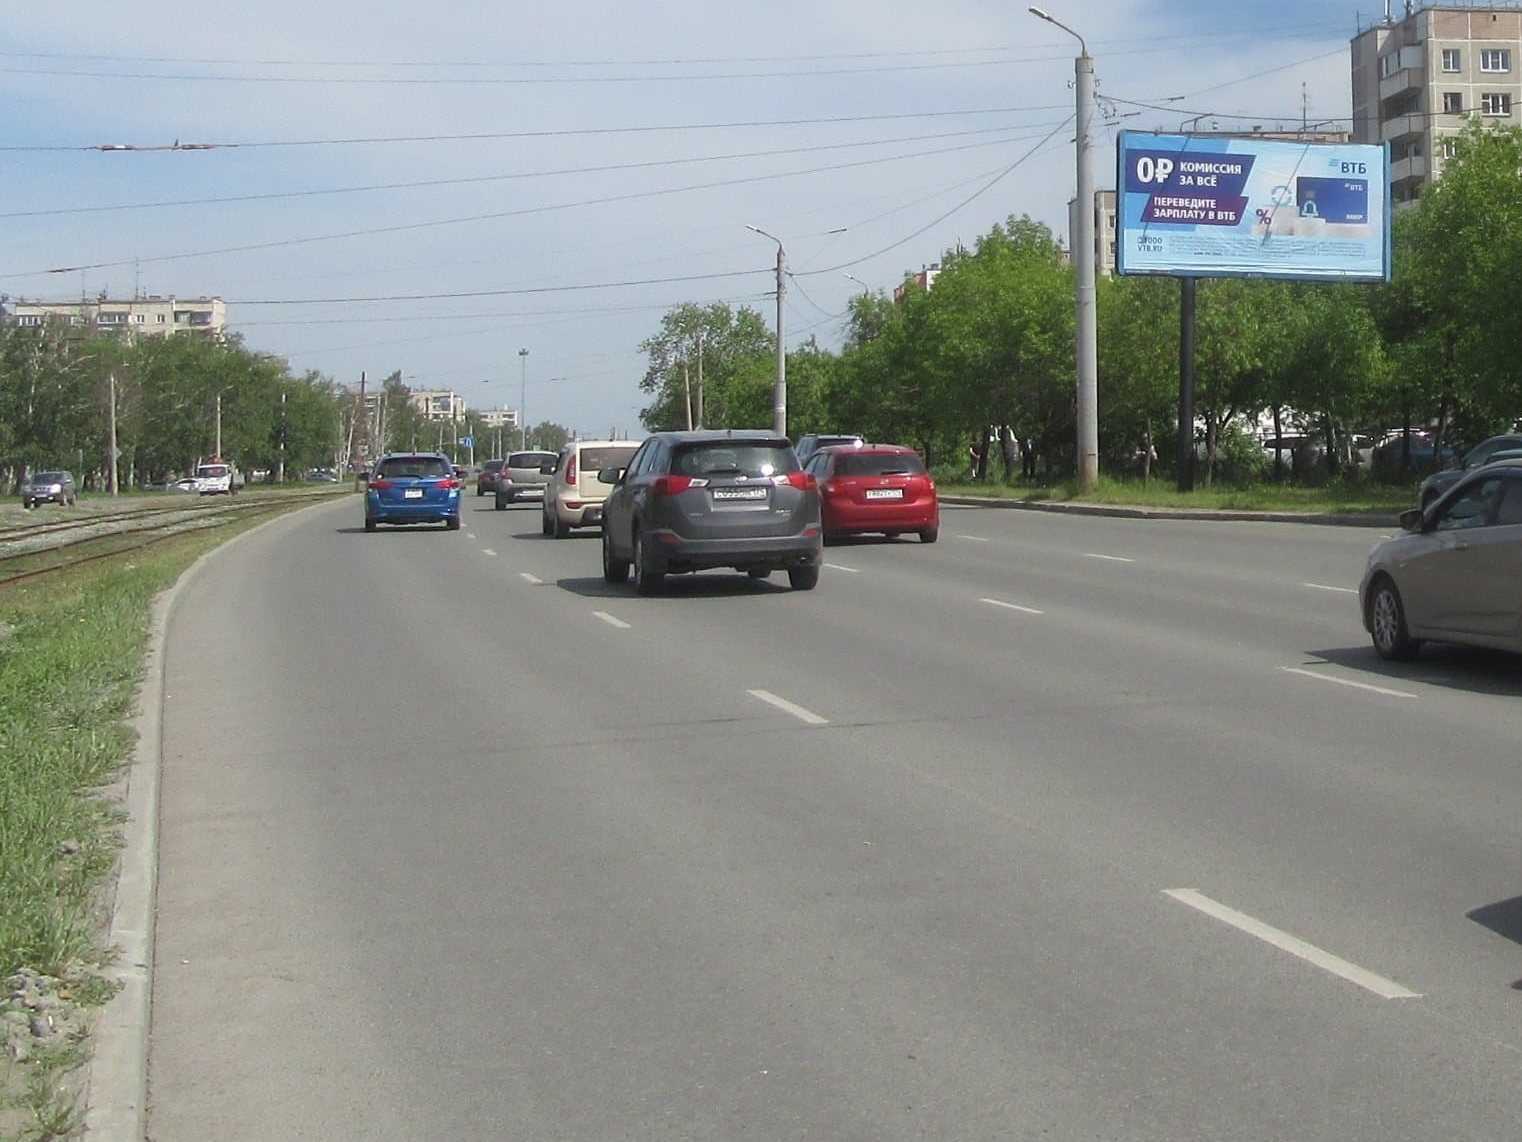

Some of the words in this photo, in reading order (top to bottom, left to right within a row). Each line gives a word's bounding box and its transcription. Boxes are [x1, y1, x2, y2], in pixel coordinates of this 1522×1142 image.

[1180, 161, 1242, 175] КОМИССИЯ
[1341, 161, 1367, 174] ВТБ
[1179, 176, 1194, 186] ЗА
[1197, 175, 1217, 187] ВСЁ
[1154, 197, 1217, 209] ПЕРЕВЕДИТЕ
[1153, 208, 1206, 220] ЗАРПЛАТУ
[1208, 211, 1215, 220] В
[1217, 211, 1236, 221] ВТБ
